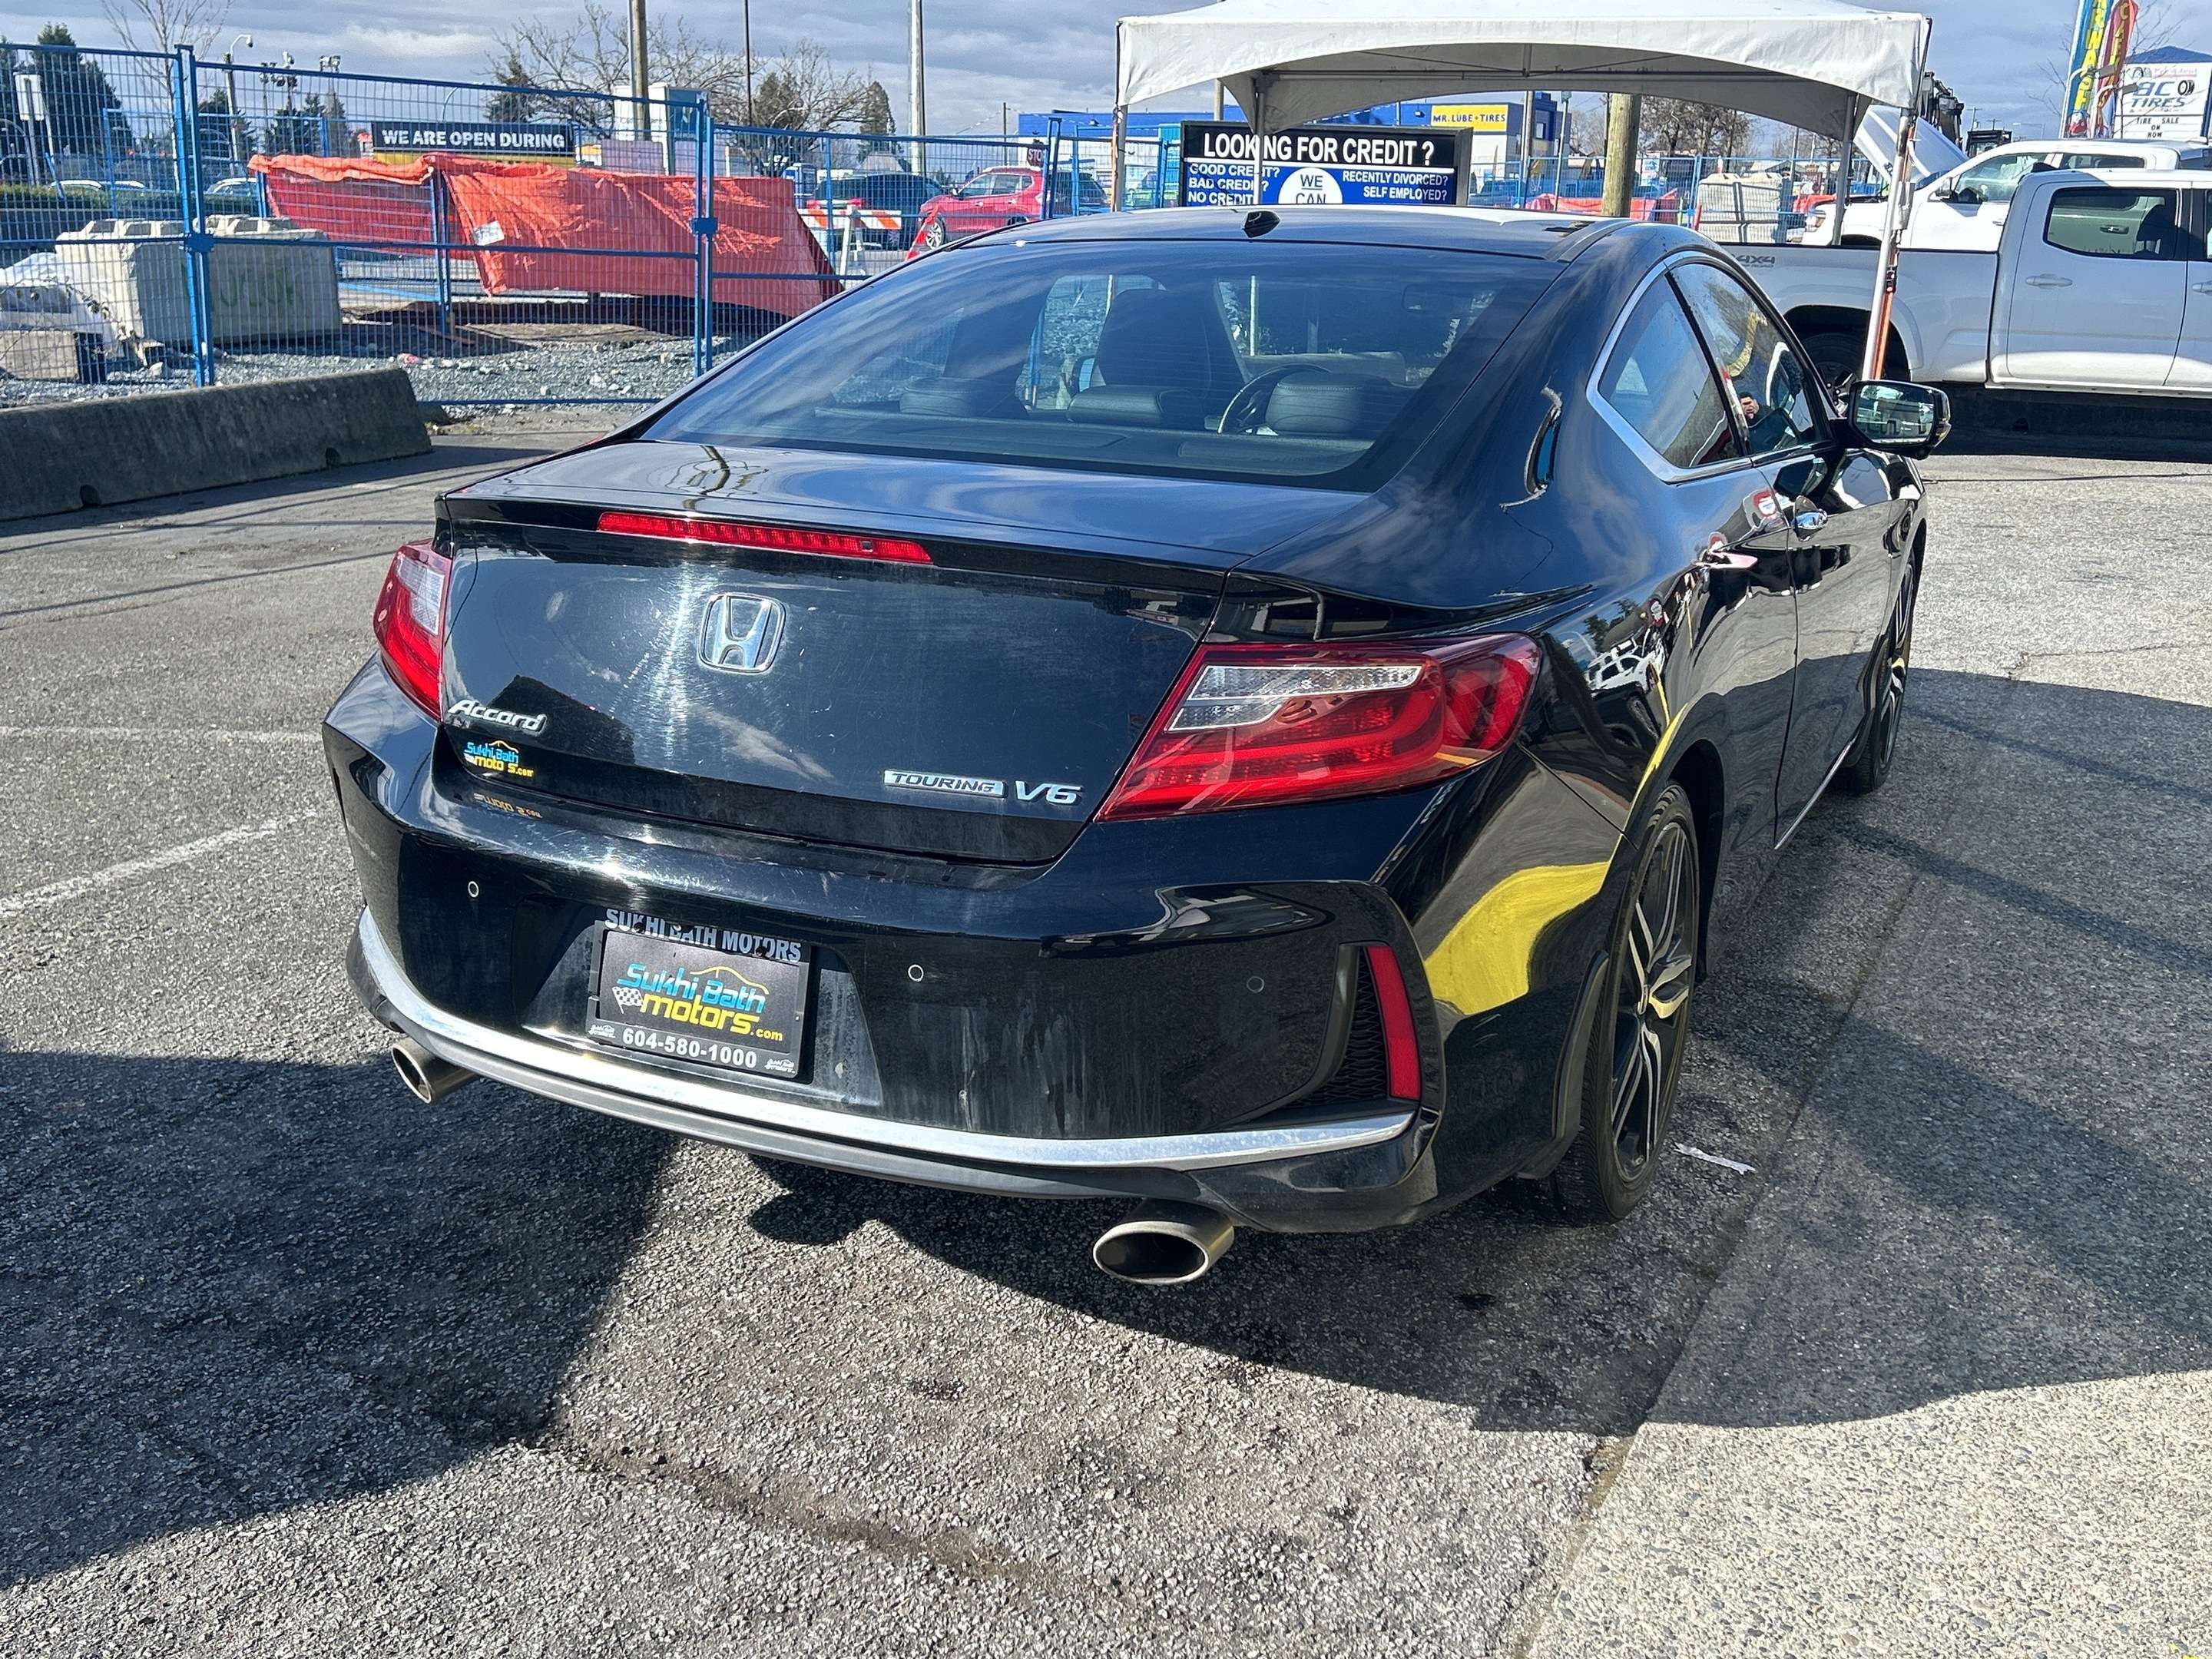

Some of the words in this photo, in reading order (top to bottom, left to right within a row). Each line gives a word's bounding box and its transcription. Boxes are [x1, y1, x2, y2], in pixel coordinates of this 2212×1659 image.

[2131, 98, 2187, 108] TIRES
[382, 130, 409, 145] WE
[412, 131, 447, 146] ARE
[449, 131, 496, 147] OPEN
[500, 132, 565, 149] DURING
[1028, 147, 1043, 161] STO
[1204, 133, 1292, 161] LOOKNG
[1297, 136, 1338, 162] FOR
[1343, 138, 1418, 165] CREDIT
[1190, 163, 1226, 176] GOOD
[1233, 164, 1280, 177] CREIT?
[1189, 178, 1214, 189] BAD
[1217, 179, 1269, 191] CREDI?
[1300, 174, 1323, 188] WE
[1343, 171, 1391, 183] RECENTLY
[1394, 174, 1449, 187] DIVORCED?
[1188, 191, 1206, 203] NO
[1363, 186, 1386, 198] SELF
[1389, 187, 1448, 202] EMPLOYED?
[448, 700, 546, 732] Accord
[465, 741, 494, 757] Sukhi
[496, 749, 519, 763] Bath
[893, 773, 996, 793] TOURING
[1015, 780, 1083, 805] V6
[605, 909, 665, 939] SUKHI
[722, 931, 802, 963] MOTORS
[617, 962, 699, 1000] Sukhi
[702, 979, 767, 1014] Bath
[622, 1028, 757, 1069] 604-580-1000
